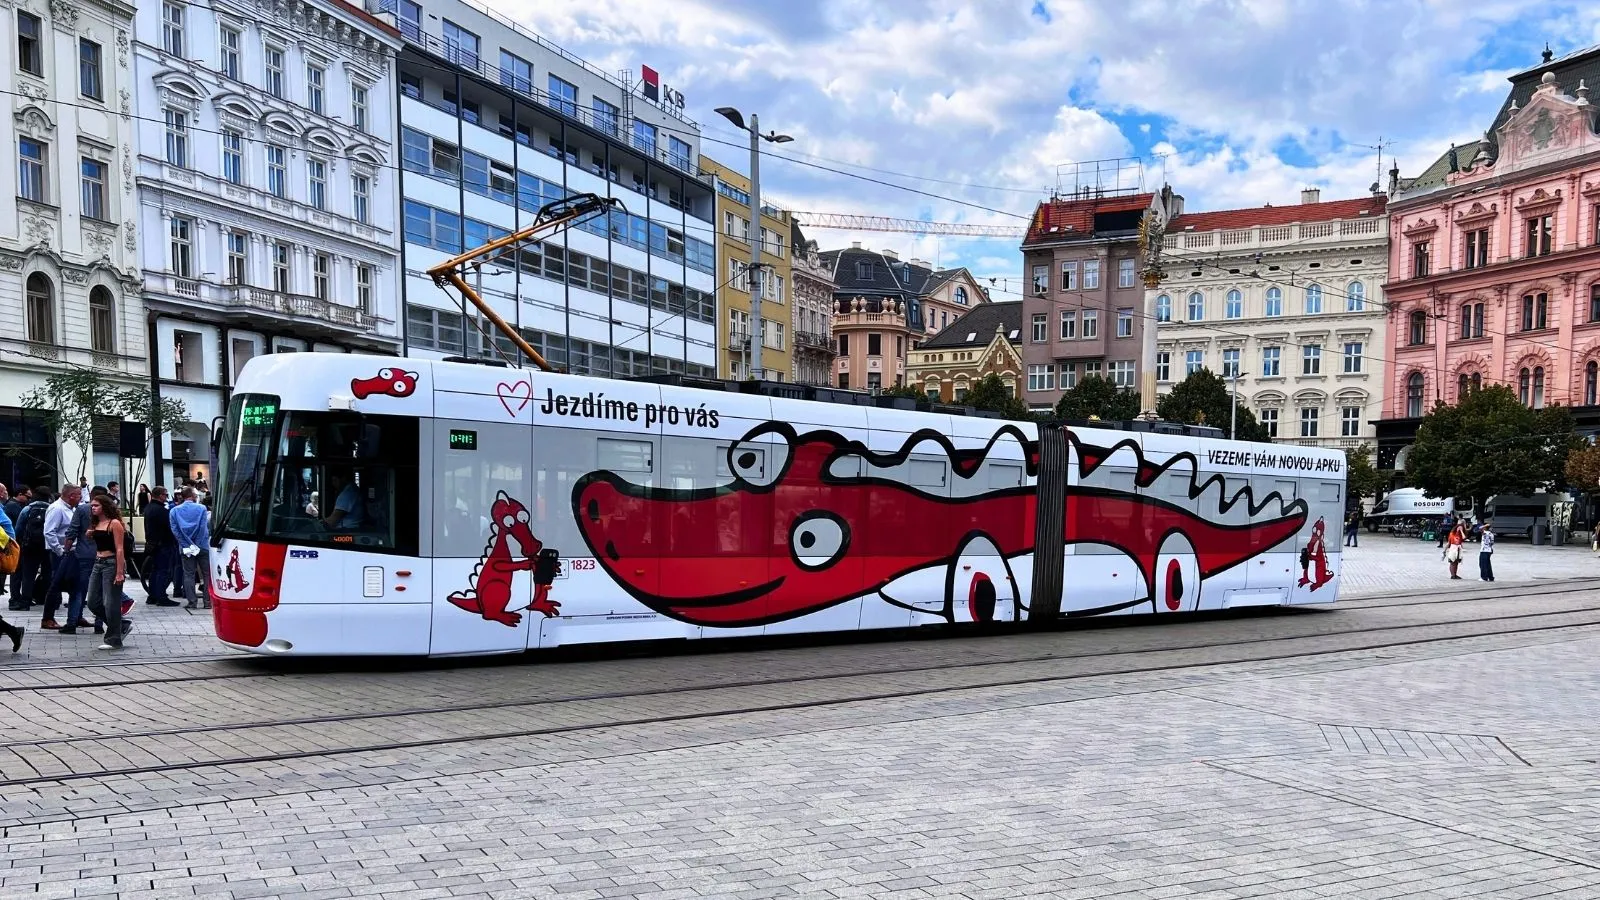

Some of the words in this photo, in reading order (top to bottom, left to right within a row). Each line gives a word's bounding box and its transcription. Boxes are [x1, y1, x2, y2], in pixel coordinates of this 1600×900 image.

[663, 84, 685, 109] KB
[541, 388, 638, 421] Jezdíme
[645, 403, 679, 428] pro
[685, 403, 719, 428] vás
[1208, 450, 1251, 467] VEZEME
[1254, 450, 1276, 469] VÁM
[1278, 455, 1314, 471] NOVOU
[1315, 458, 1340, 473] APKU
[570, 559, 596, 571] 1823
